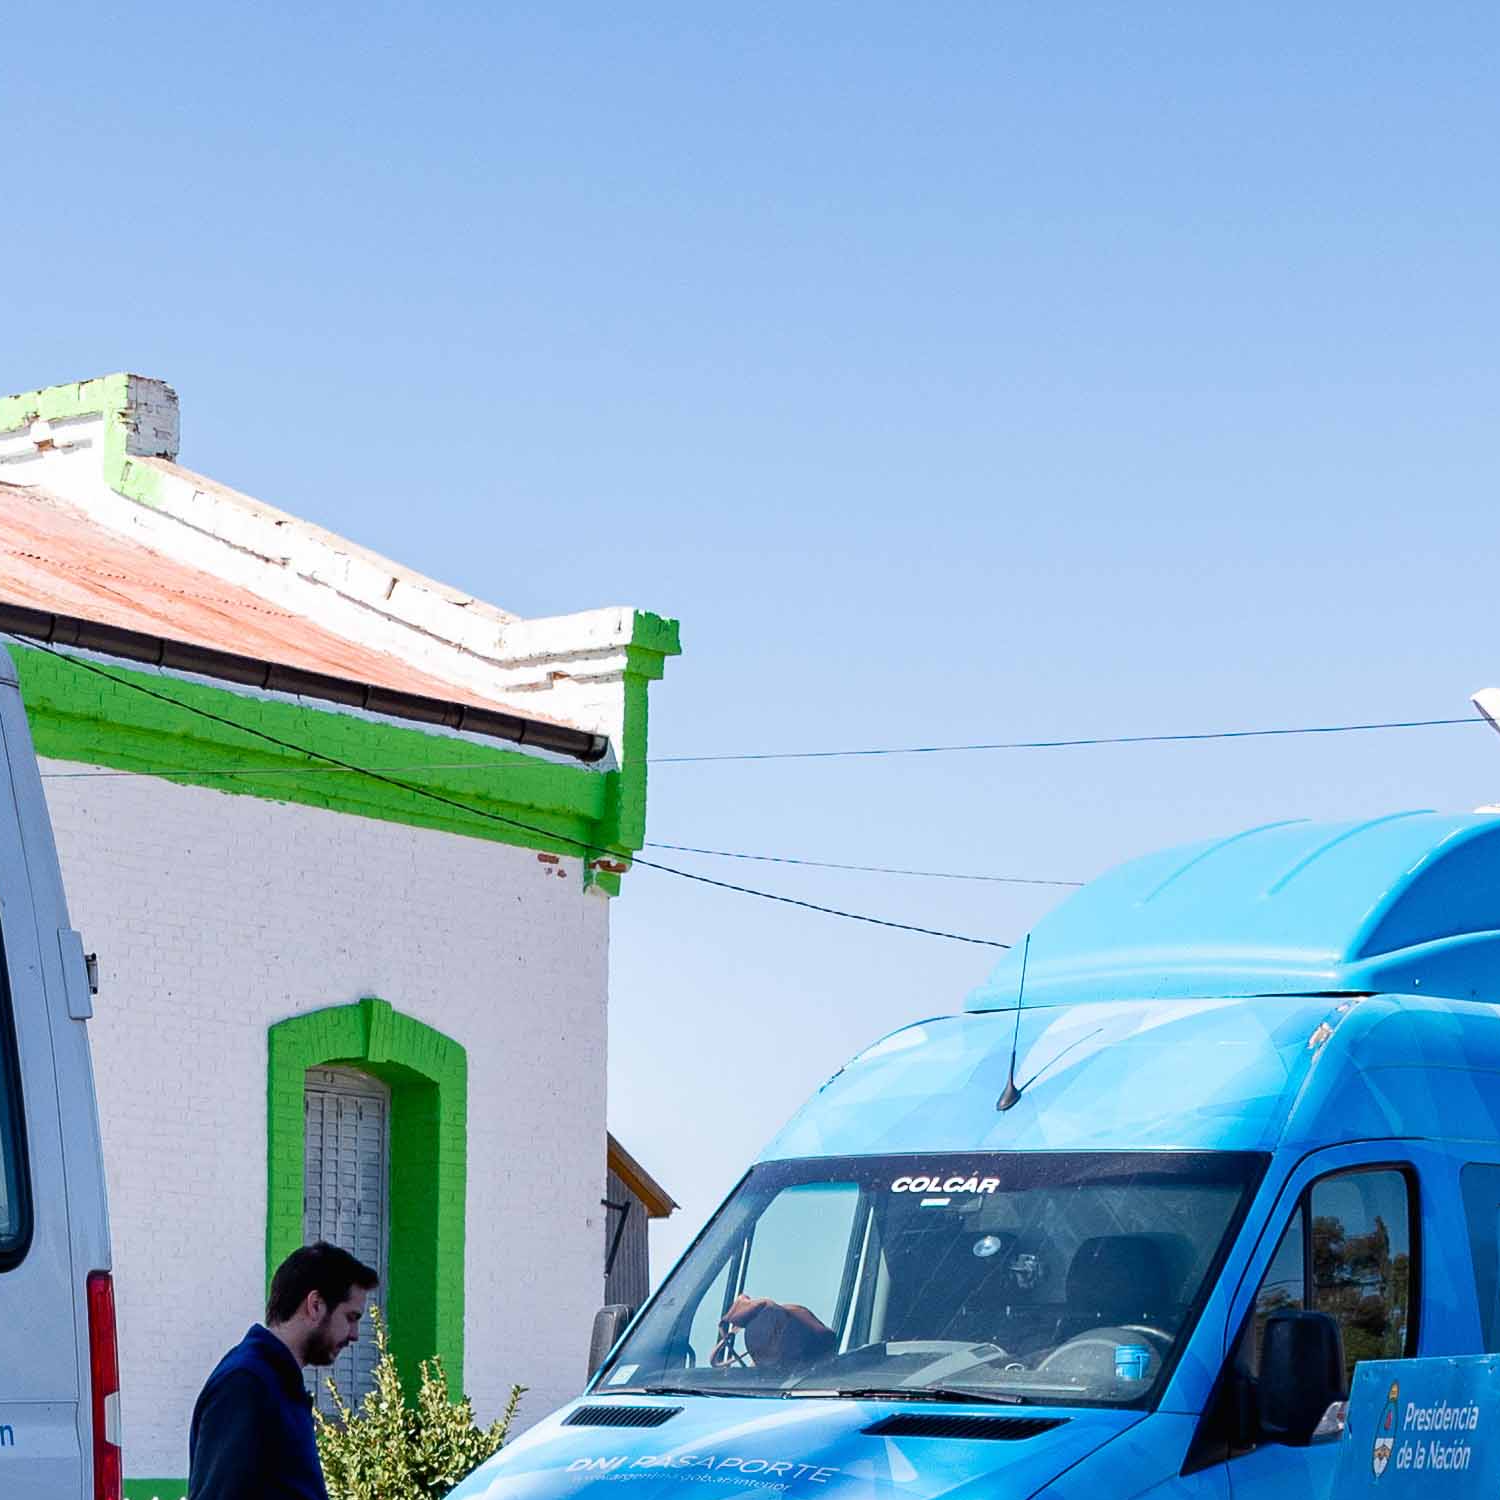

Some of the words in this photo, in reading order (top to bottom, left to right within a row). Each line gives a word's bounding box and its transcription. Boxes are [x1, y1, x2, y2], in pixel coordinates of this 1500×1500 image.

[1403, 1400, 1479, 1431] Presidencia
[566, 1456, 628, 1472] DNI
[630, 1454, 840, 1484] PASAPORTE
[1397, 1440, 1412, 1469] de
[1413, 1440, 1425, 1469] la
[1426, 1439, 1471, 1469] Nación
